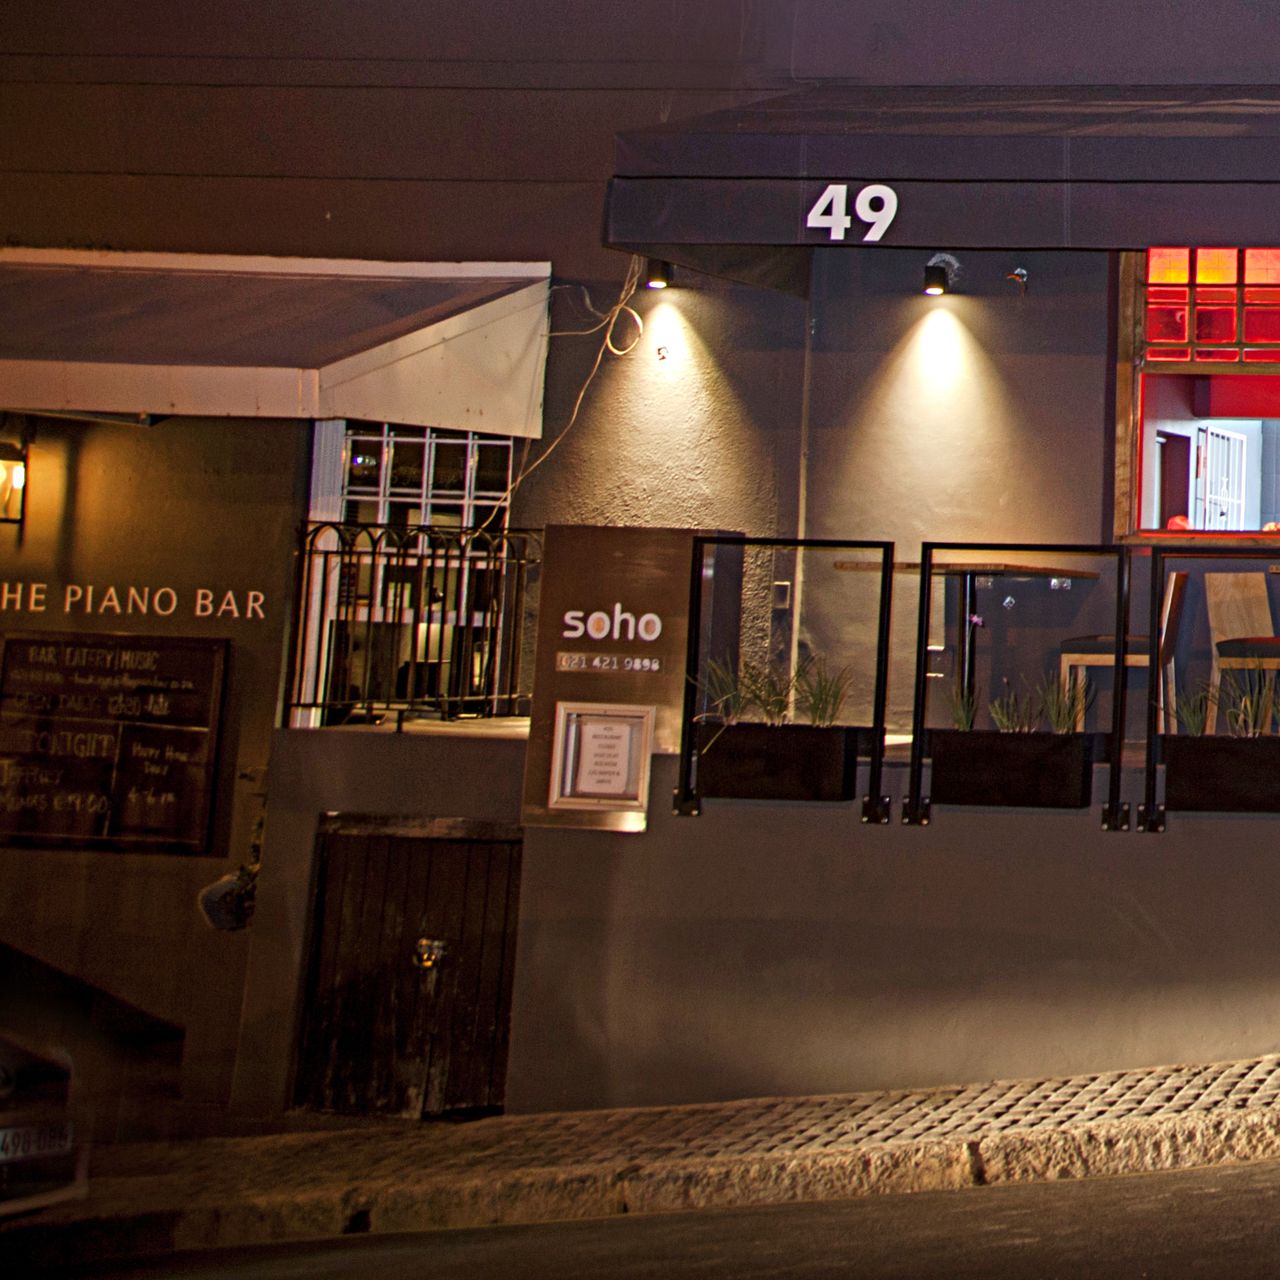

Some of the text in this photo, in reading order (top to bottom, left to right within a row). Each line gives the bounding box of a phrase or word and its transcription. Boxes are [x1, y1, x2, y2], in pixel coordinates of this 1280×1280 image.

[807, 184, 898, 242] 49
[64, 585, 178, 616] PIANO
[195, 588, 265, 619] BAR
[563, 602, 662, 641] soho
